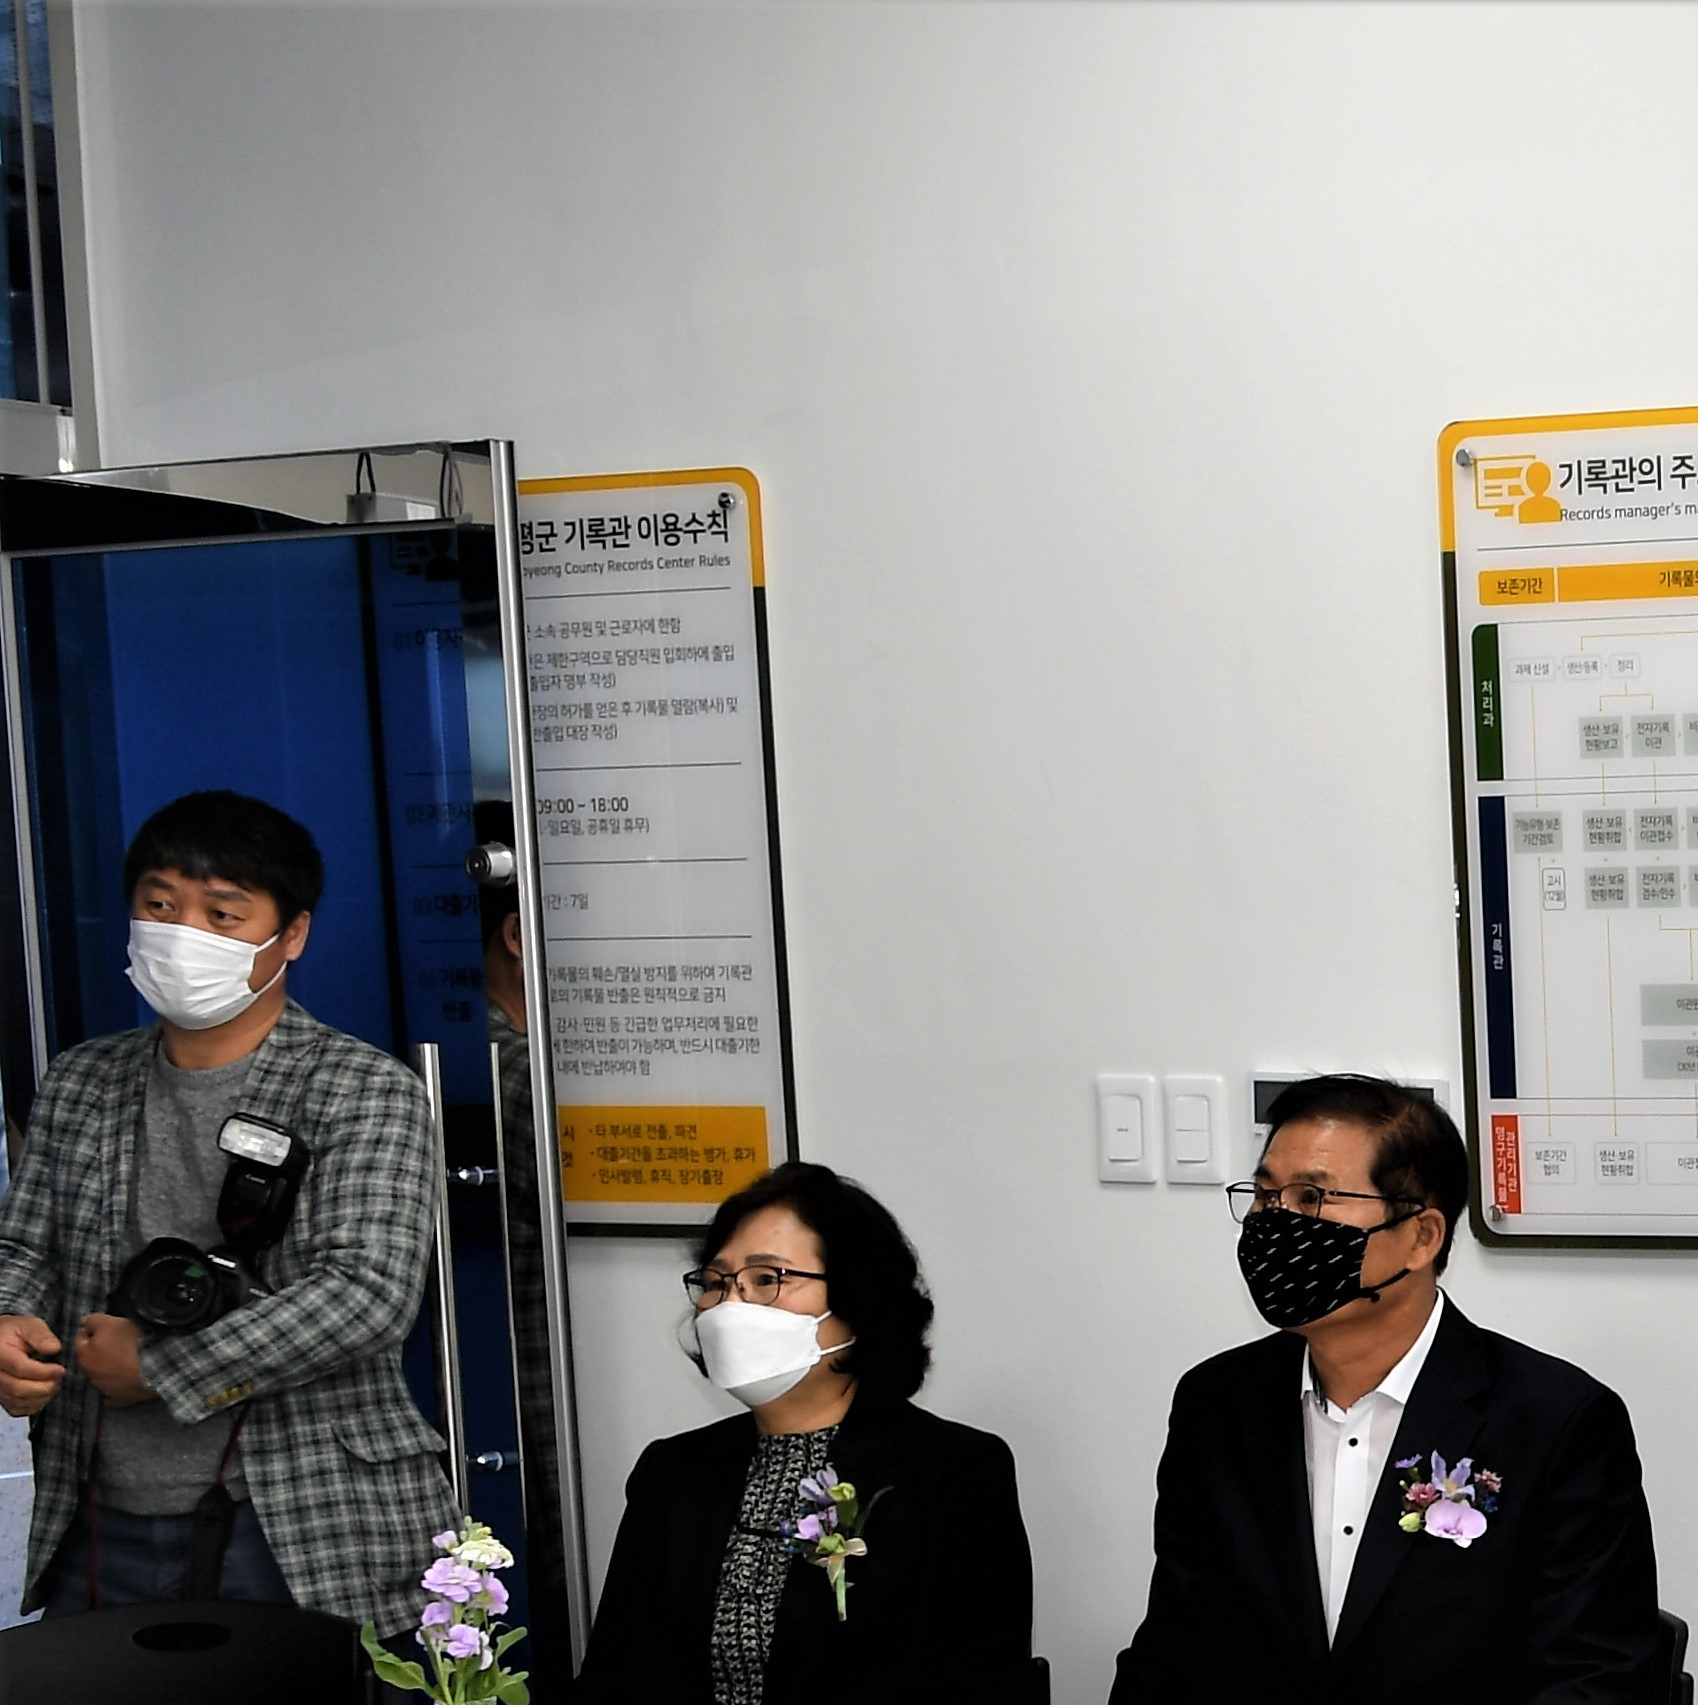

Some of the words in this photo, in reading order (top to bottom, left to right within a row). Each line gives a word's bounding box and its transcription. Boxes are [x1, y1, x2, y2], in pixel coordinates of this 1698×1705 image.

[1558, 456, 1662, 494] 기록관의
[1560, 506, 1611, 521] Records
[1612, 502, 1681, 519] manager's
[564, 516, 631, 550] 기록관
[638, 510, 729, 546] 이용수칙
[564, 562, 604, 576] County
[608, 558, 653, 571] Records
[657, 556, 694, 569] Center
[700, 555, 730, 567] Rules
[1496, 577, 1542, 596] 보존기간
[1481, 680, 1494, 728] 처리과
[591, 797, 629, 812] 18:00
